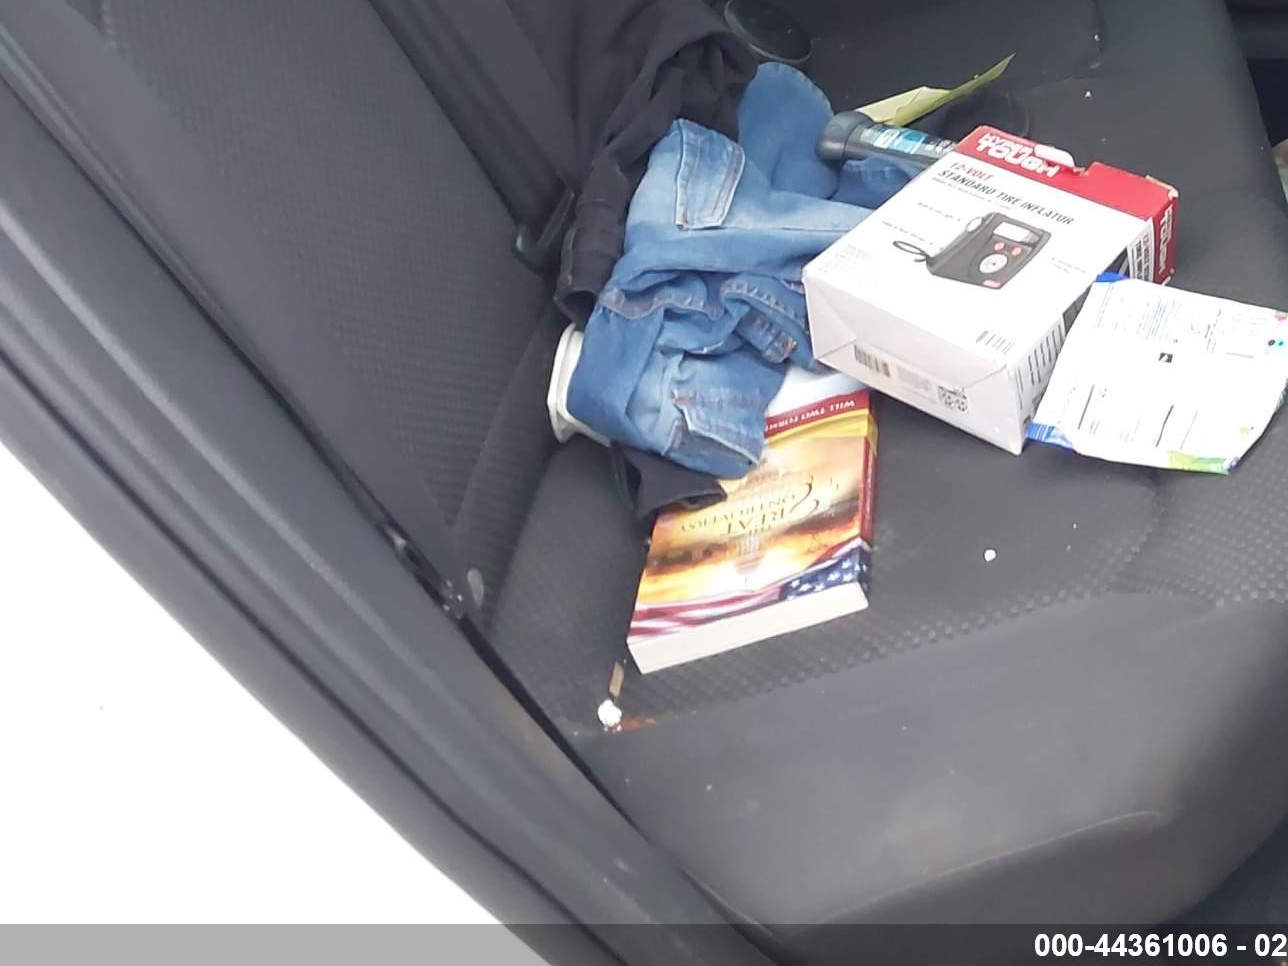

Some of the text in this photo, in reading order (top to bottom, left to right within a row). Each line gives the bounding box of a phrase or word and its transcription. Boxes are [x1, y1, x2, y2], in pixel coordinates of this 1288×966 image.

[976, 138, 1061, 178] TOUGH
[949, 162, 994, 182] 12-VOLT
[938, 170, 997, 195] STANDARD
[997, 192, 1022, 206] TIRE
[1020, 201, 1075, 225] INFLATOR
[800, 407, 826, 421] TWO
[829, 399, 857, 412] WILL
